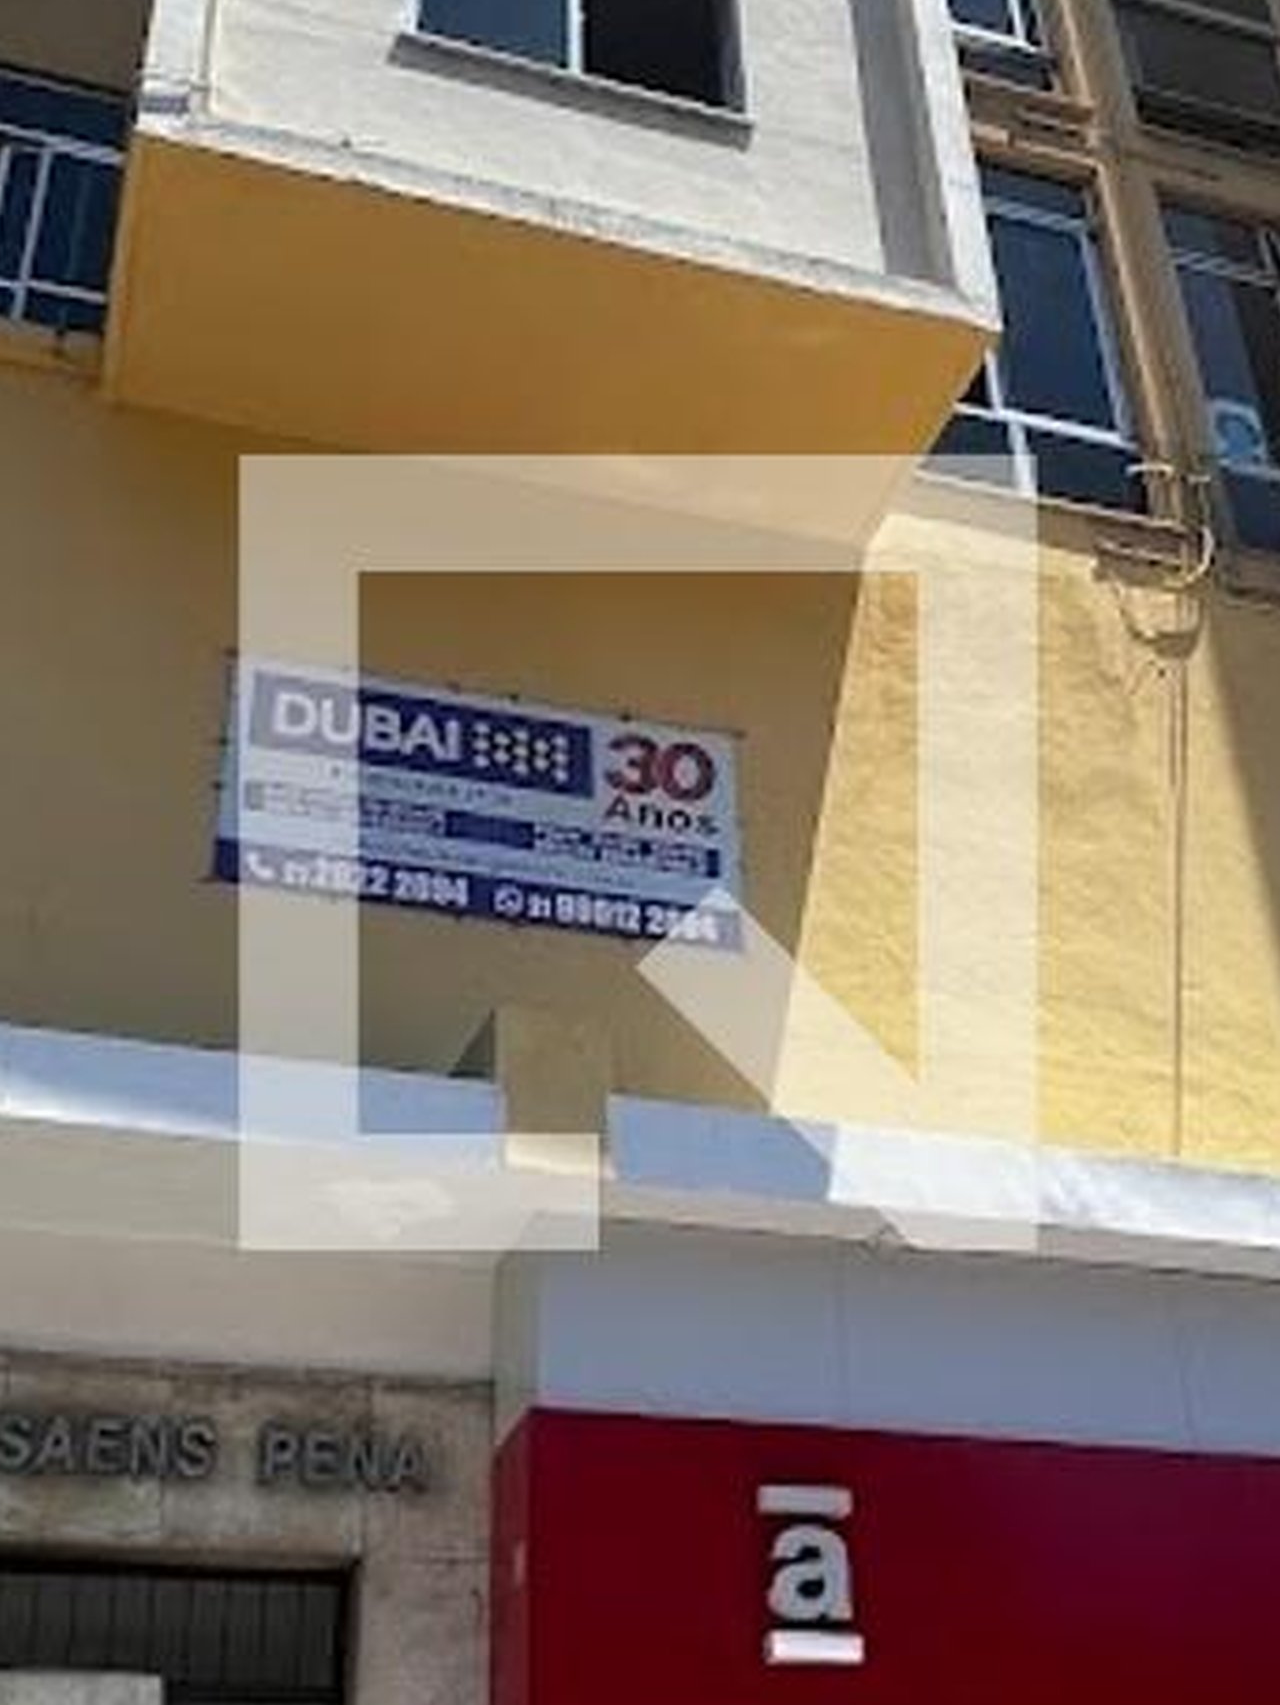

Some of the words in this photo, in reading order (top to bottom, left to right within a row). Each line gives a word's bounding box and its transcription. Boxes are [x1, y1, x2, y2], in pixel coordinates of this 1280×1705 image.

[272, 693, 462, 762] DUBAI
[604, 736, 715, 801] 30
[606, 796, 720, 836] Anos
